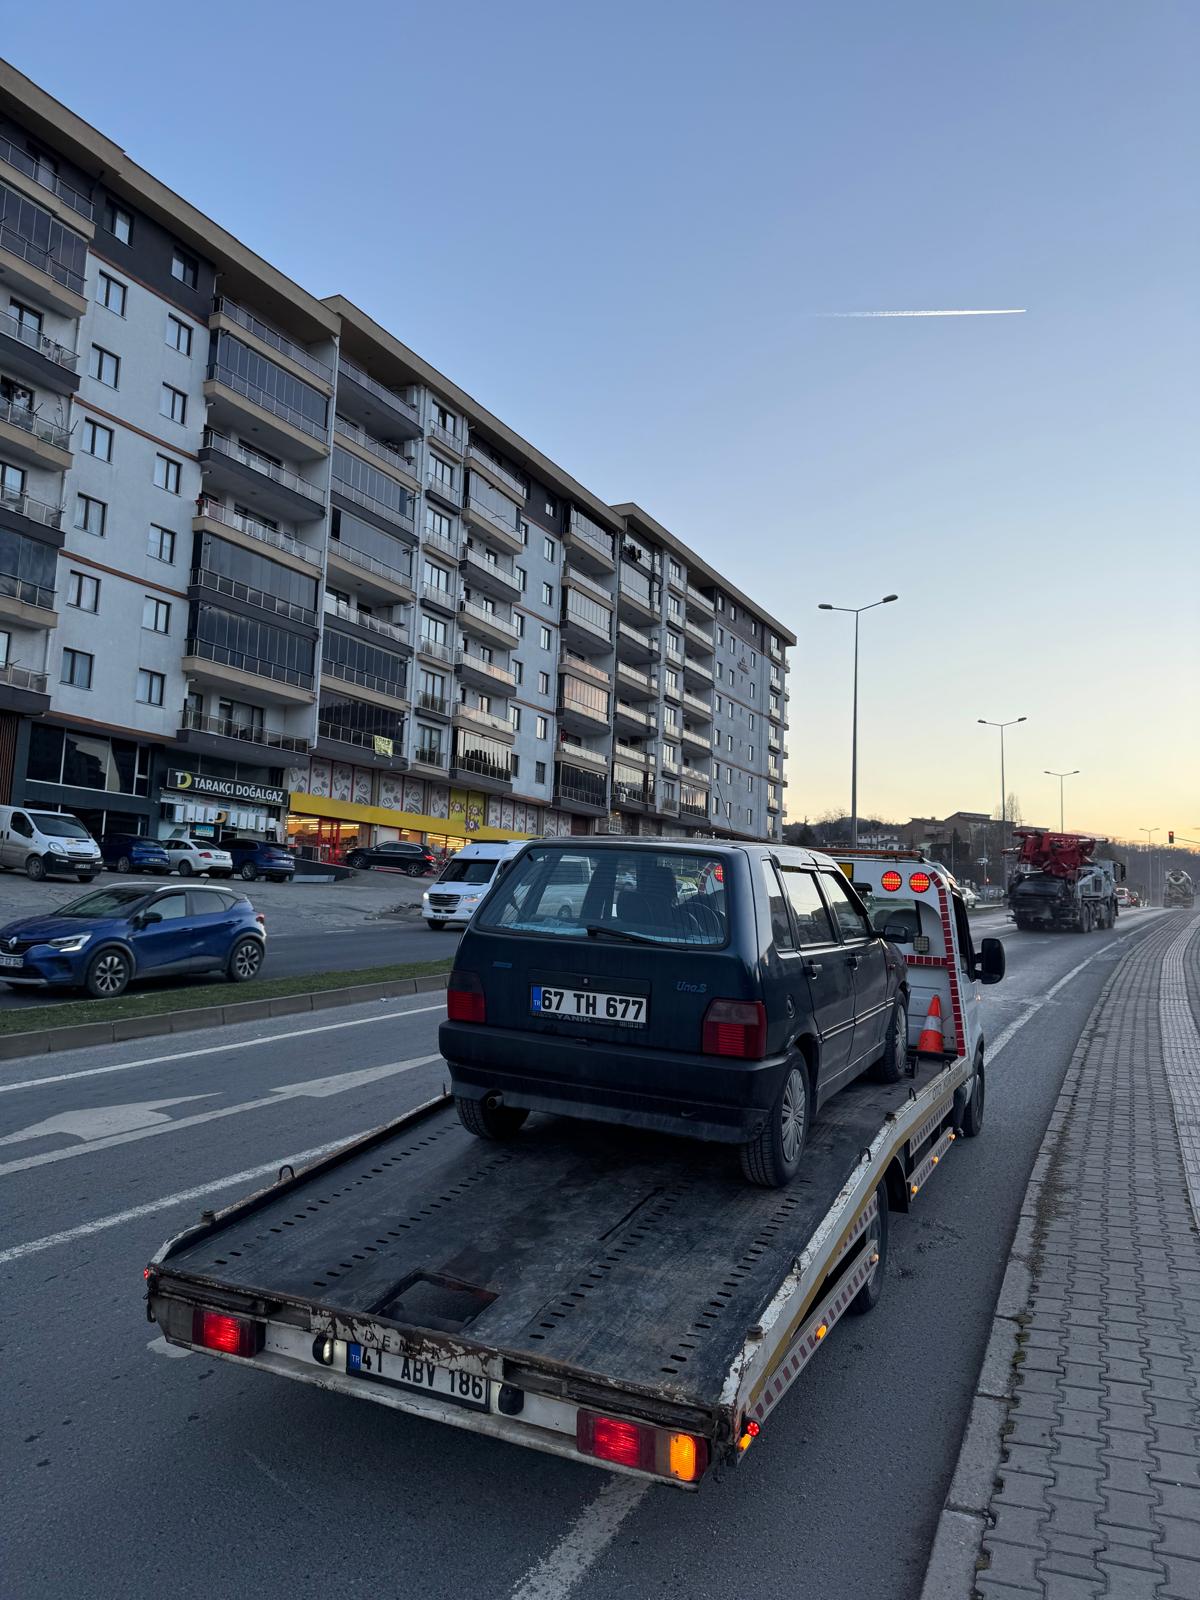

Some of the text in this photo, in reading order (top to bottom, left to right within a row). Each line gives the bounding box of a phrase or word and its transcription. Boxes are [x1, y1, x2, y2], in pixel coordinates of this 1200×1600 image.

[194, 777, 234, 795] TARAKÇI
[236, 784, 283, 803] DOĞALGAZ
[533, 999, 541, 1007] TR
[541, 989, 644, 1020] 67 TH 677
[351, 1353, 360, 1364] TR
[361, 1347, 483, 1400] 41 ABV 186
